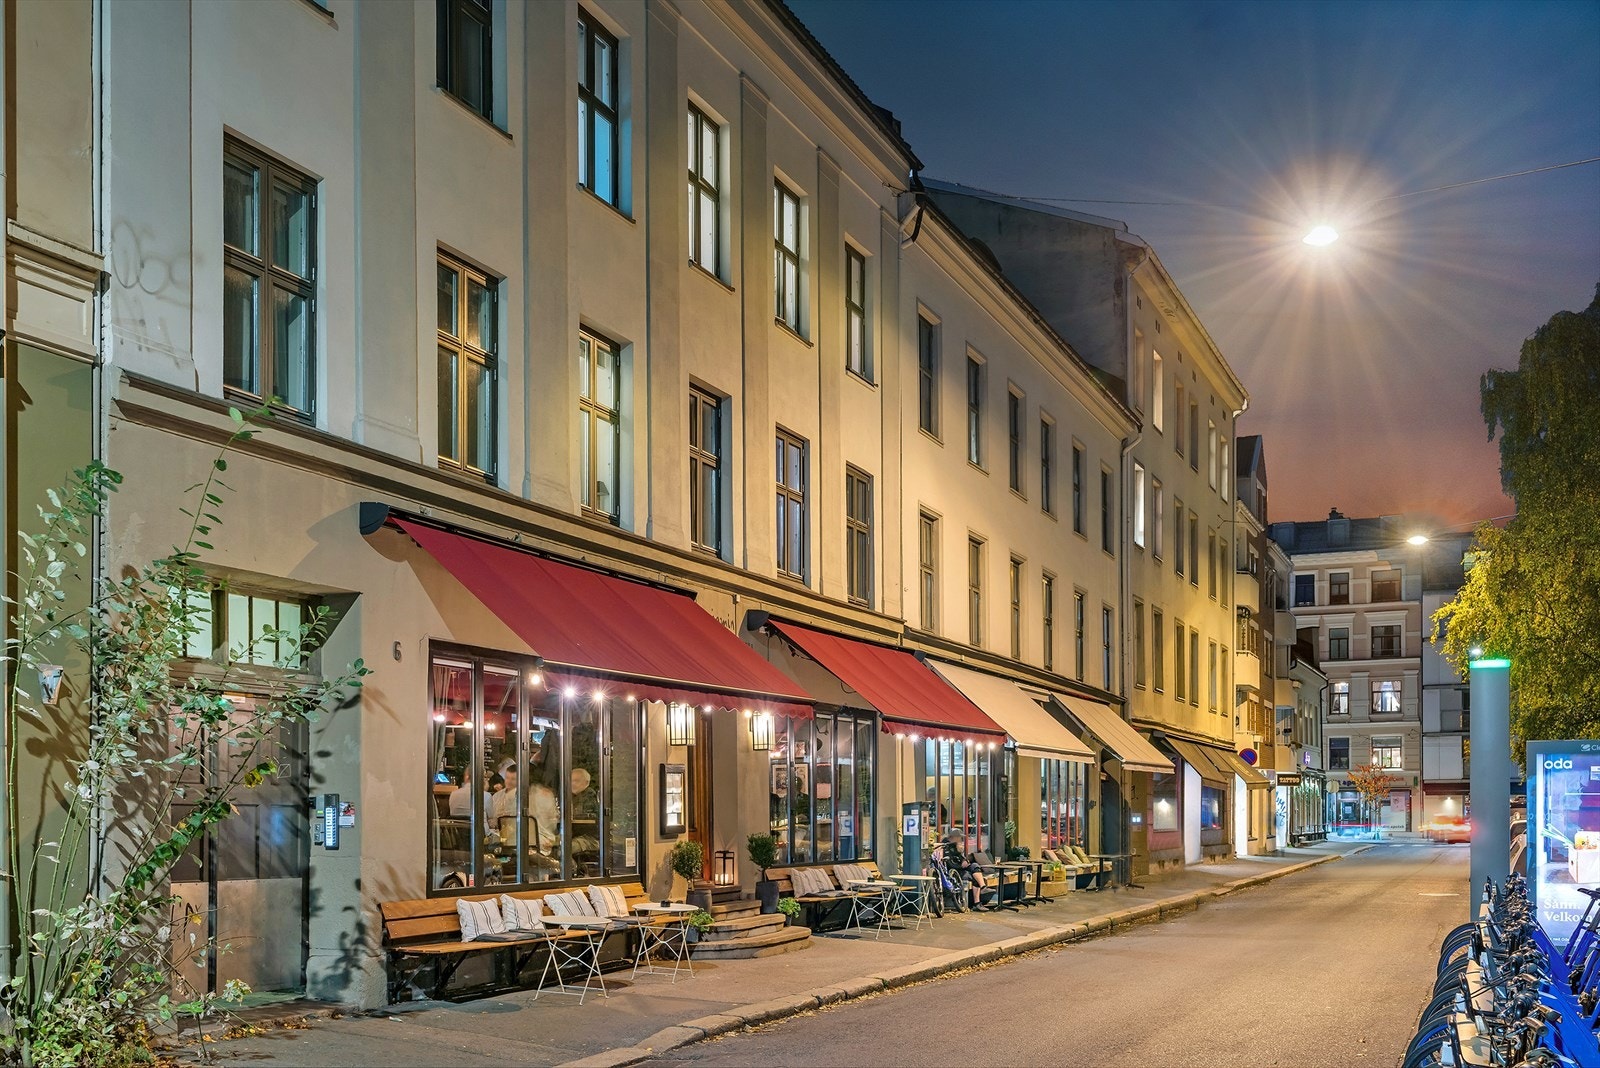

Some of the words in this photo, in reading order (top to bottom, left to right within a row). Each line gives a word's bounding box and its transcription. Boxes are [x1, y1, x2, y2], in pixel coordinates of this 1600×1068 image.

[392, 640, 402, 661] 6
[1544, 757, 1573, 769] oda
[906, 818, 916, 832] P
